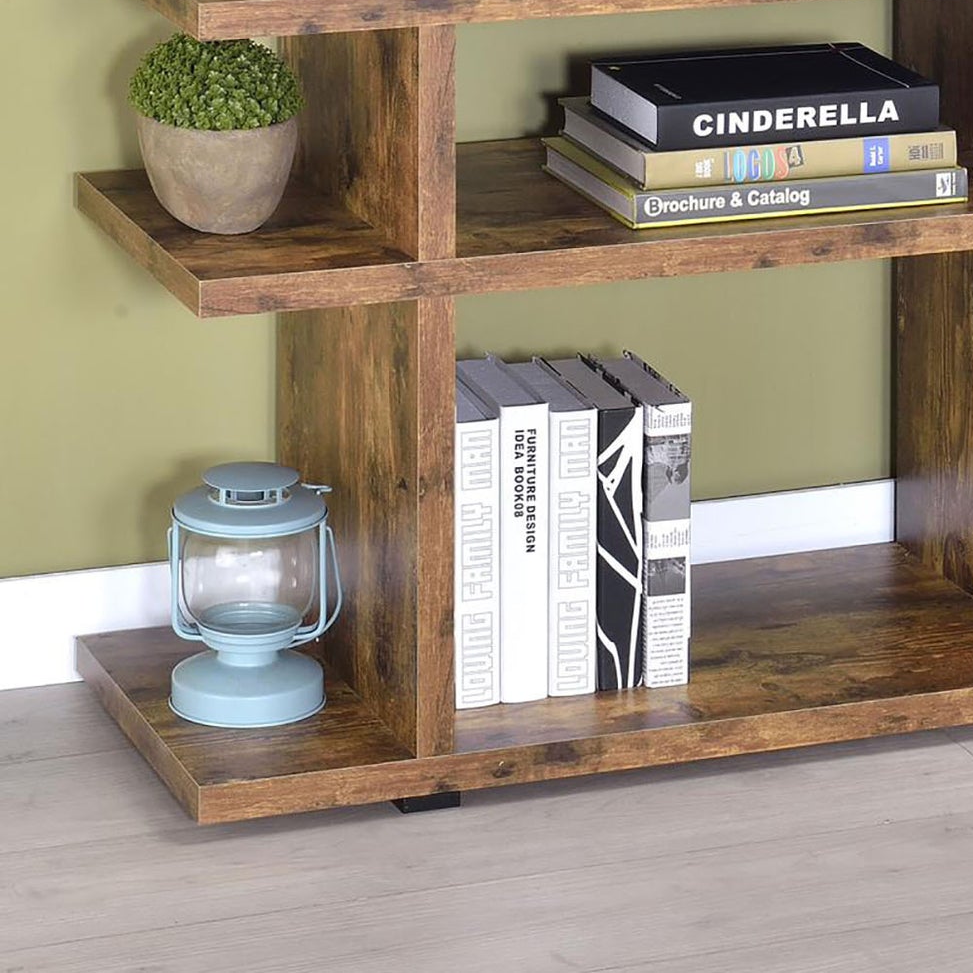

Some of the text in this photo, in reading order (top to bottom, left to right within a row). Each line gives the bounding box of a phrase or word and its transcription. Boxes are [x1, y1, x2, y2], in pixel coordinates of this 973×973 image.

[692, 99, 899, 138] CINDERELLA
[644, 187, 811, 218] Brochure & Catalog
[513, 429, 524, 518] IDEA BOOK08
[525, 428, 537, 553] FURNITURE DESIGN
[460, 429, 494, 705] LOVING FAMILY MAN
[556, 418, 590, 692] LOVING FAMILY MAN
